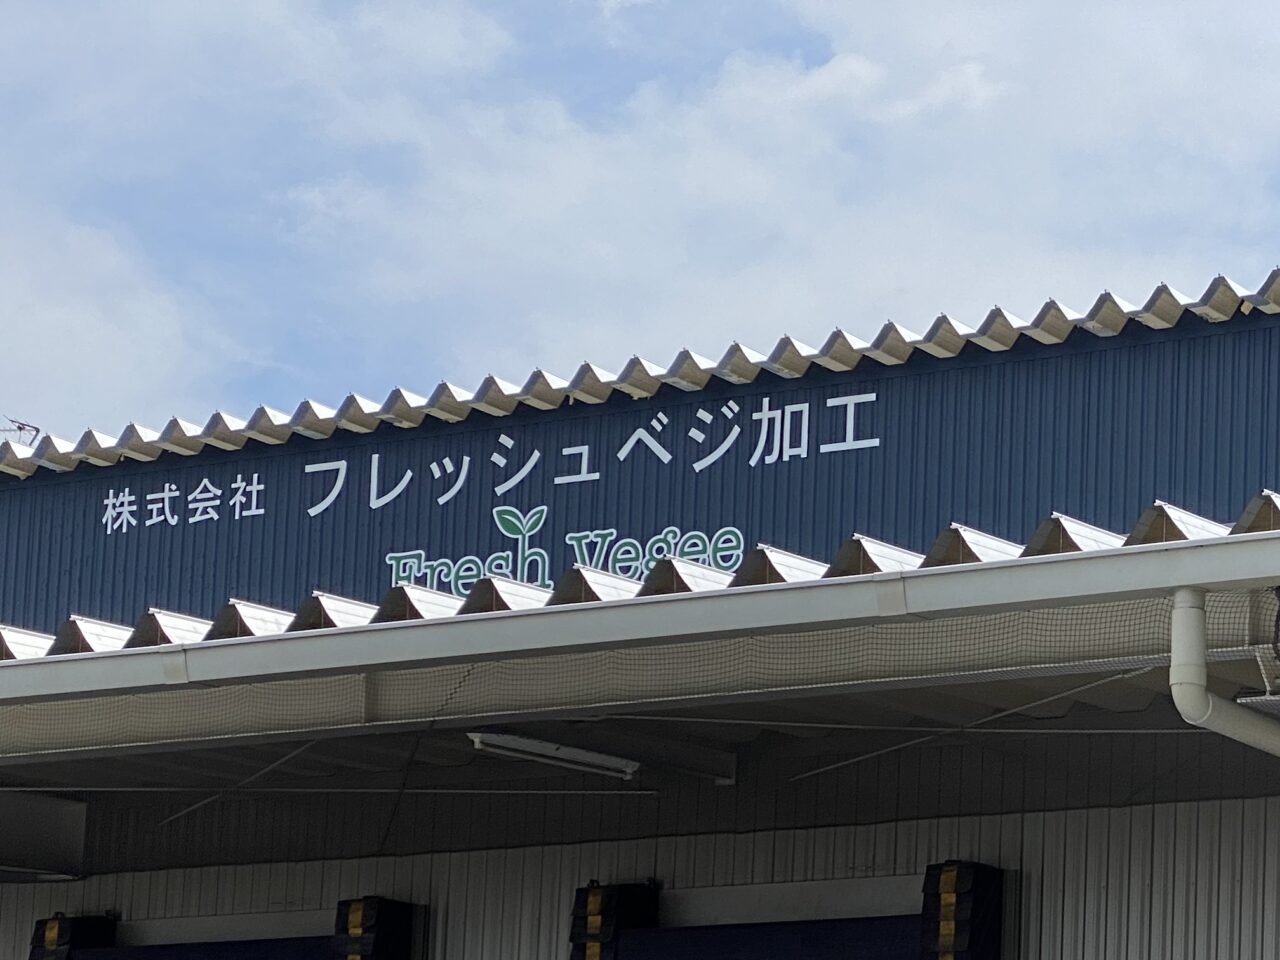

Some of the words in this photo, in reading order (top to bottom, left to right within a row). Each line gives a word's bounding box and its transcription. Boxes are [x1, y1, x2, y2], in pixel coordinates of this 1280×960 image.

[102, 473, 265, 535] 株式会社
[304, 392, 880, 517] フレッシュベジ加工
[385, 533, 554, 597] Fresh
[566, 526, 744, 584] Vegee
